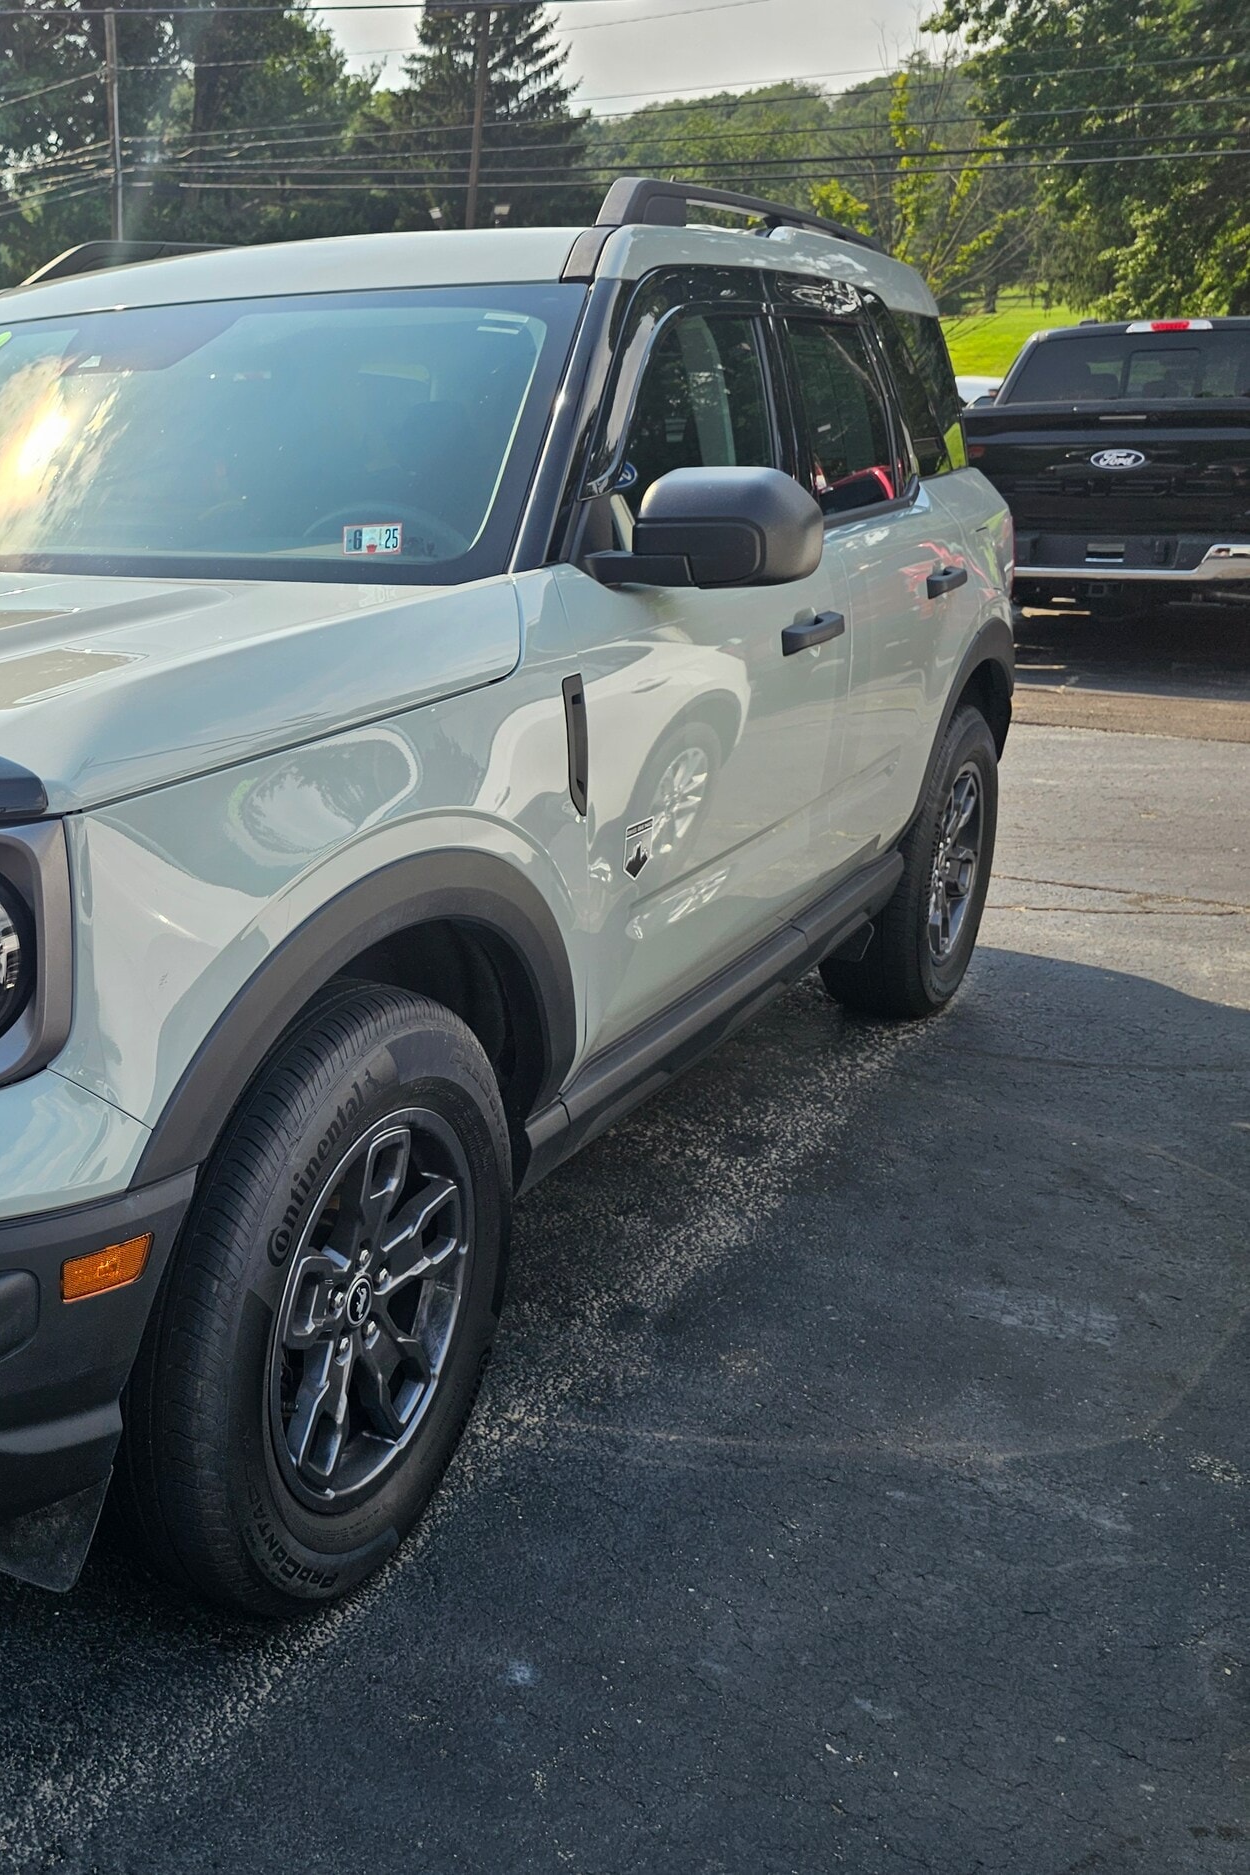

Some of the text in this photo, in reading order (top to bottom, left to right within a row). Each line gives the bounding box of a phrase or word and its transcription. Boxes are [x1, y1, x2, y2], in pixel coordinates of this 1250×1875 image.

[1099, 451, 1136, 467] Ford
[353, 528, 399, 550] 6 25
[267, 1081, 368, 1267] Continental
